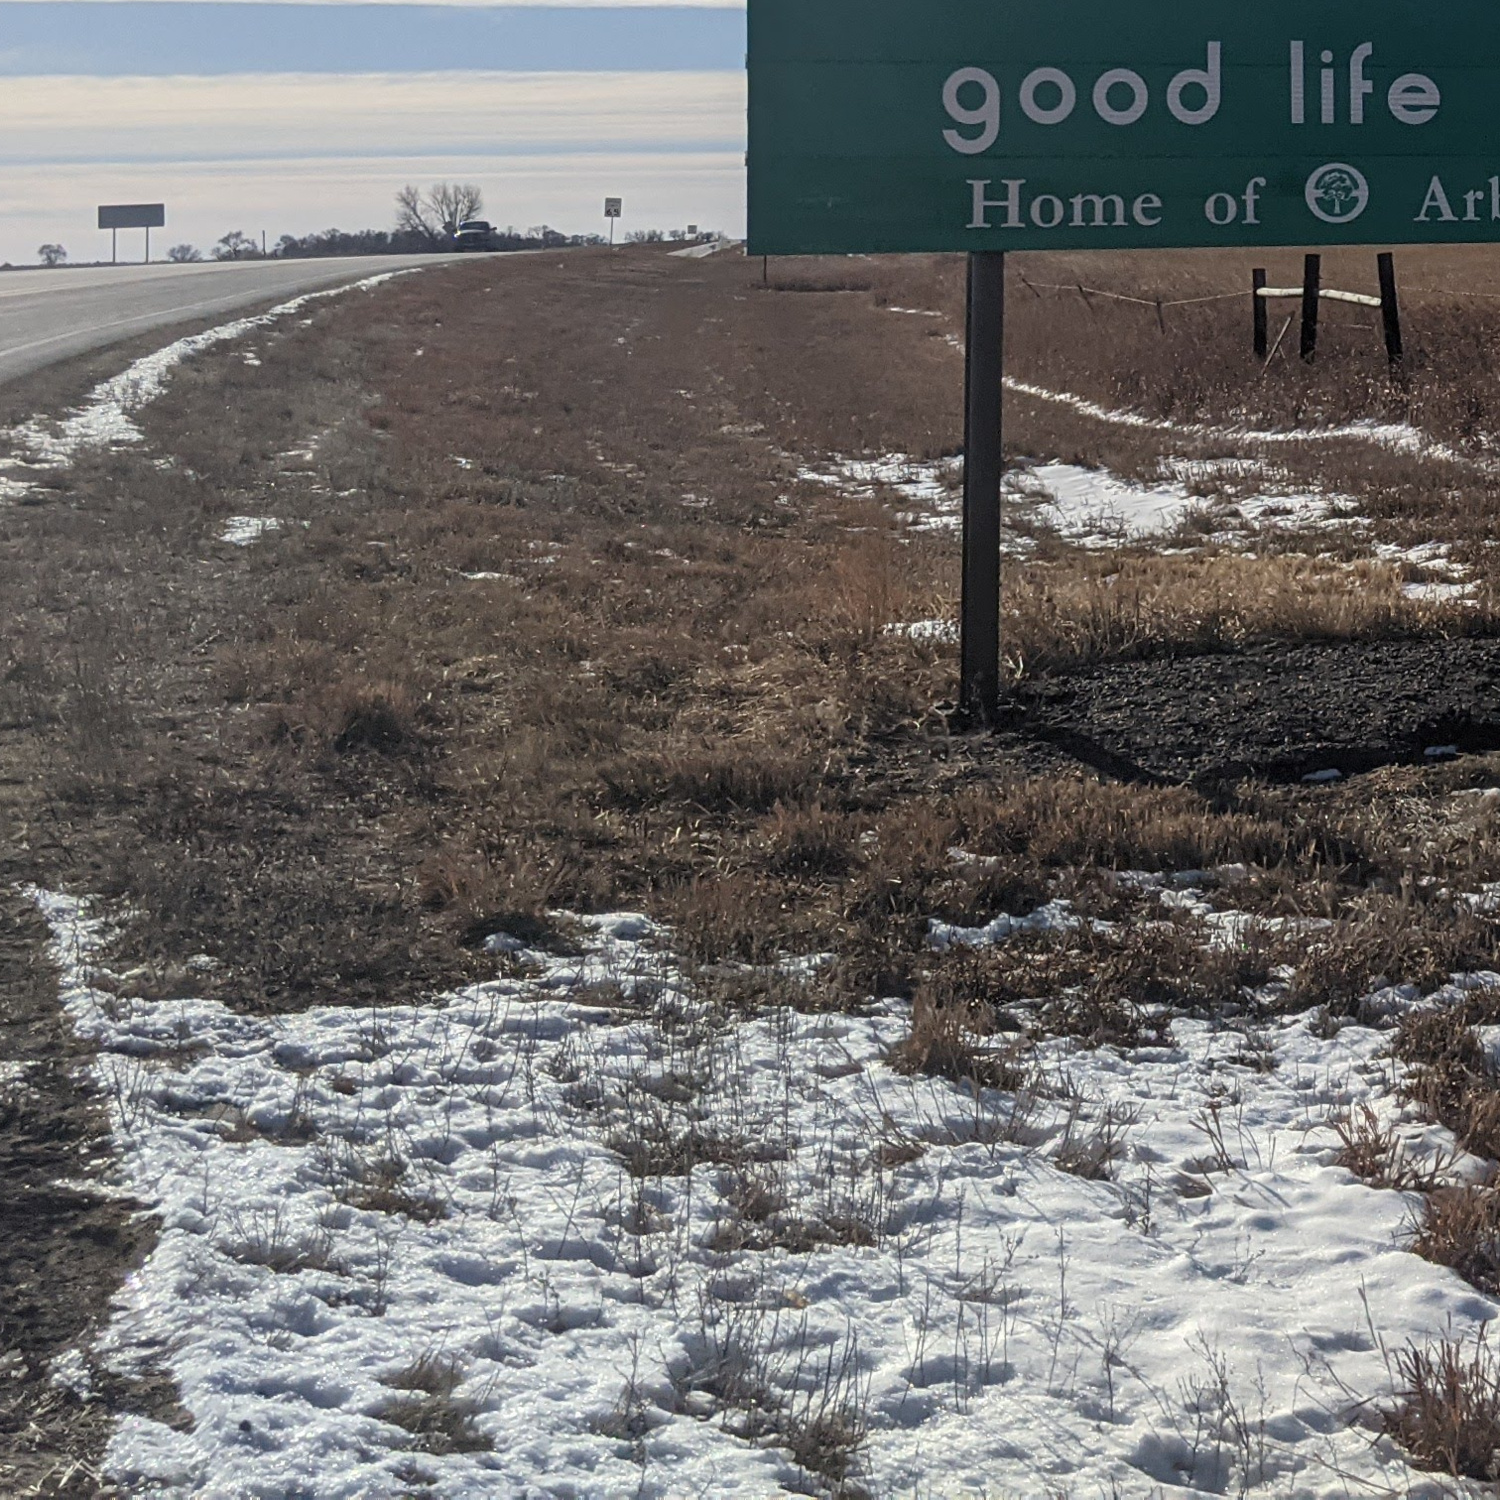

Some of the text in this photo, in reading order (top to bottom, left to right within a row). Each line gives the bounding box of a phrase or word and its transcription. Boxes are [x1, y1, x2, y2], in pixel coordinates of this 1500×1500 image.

[942, 40, 1441, 155] good life
[965, 178, 1163, 229] Home
[1205, 176, 1267, 225] of
